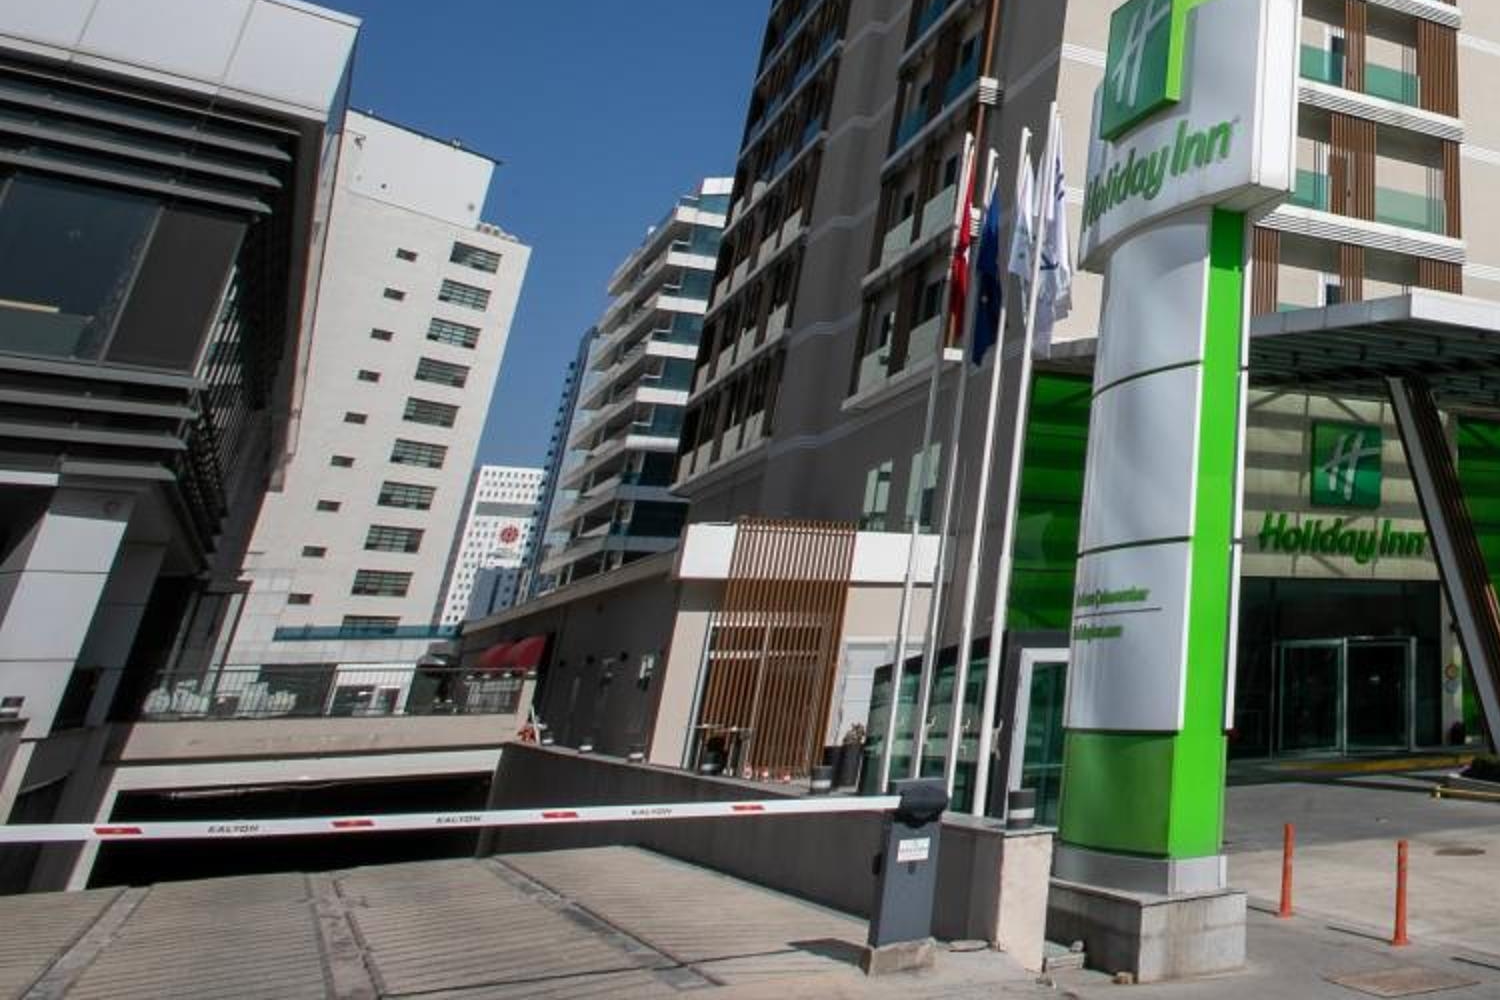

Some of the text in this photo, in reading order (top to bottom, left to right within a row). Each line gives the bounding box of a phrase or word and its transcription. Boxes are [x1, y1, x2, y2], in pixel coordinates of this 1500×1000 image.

[1082, 147, 1170, 232] Holiday
[1170, 120, 1232, 176] Inn
[1259, 511, 1425, 565] Holiday Inn
